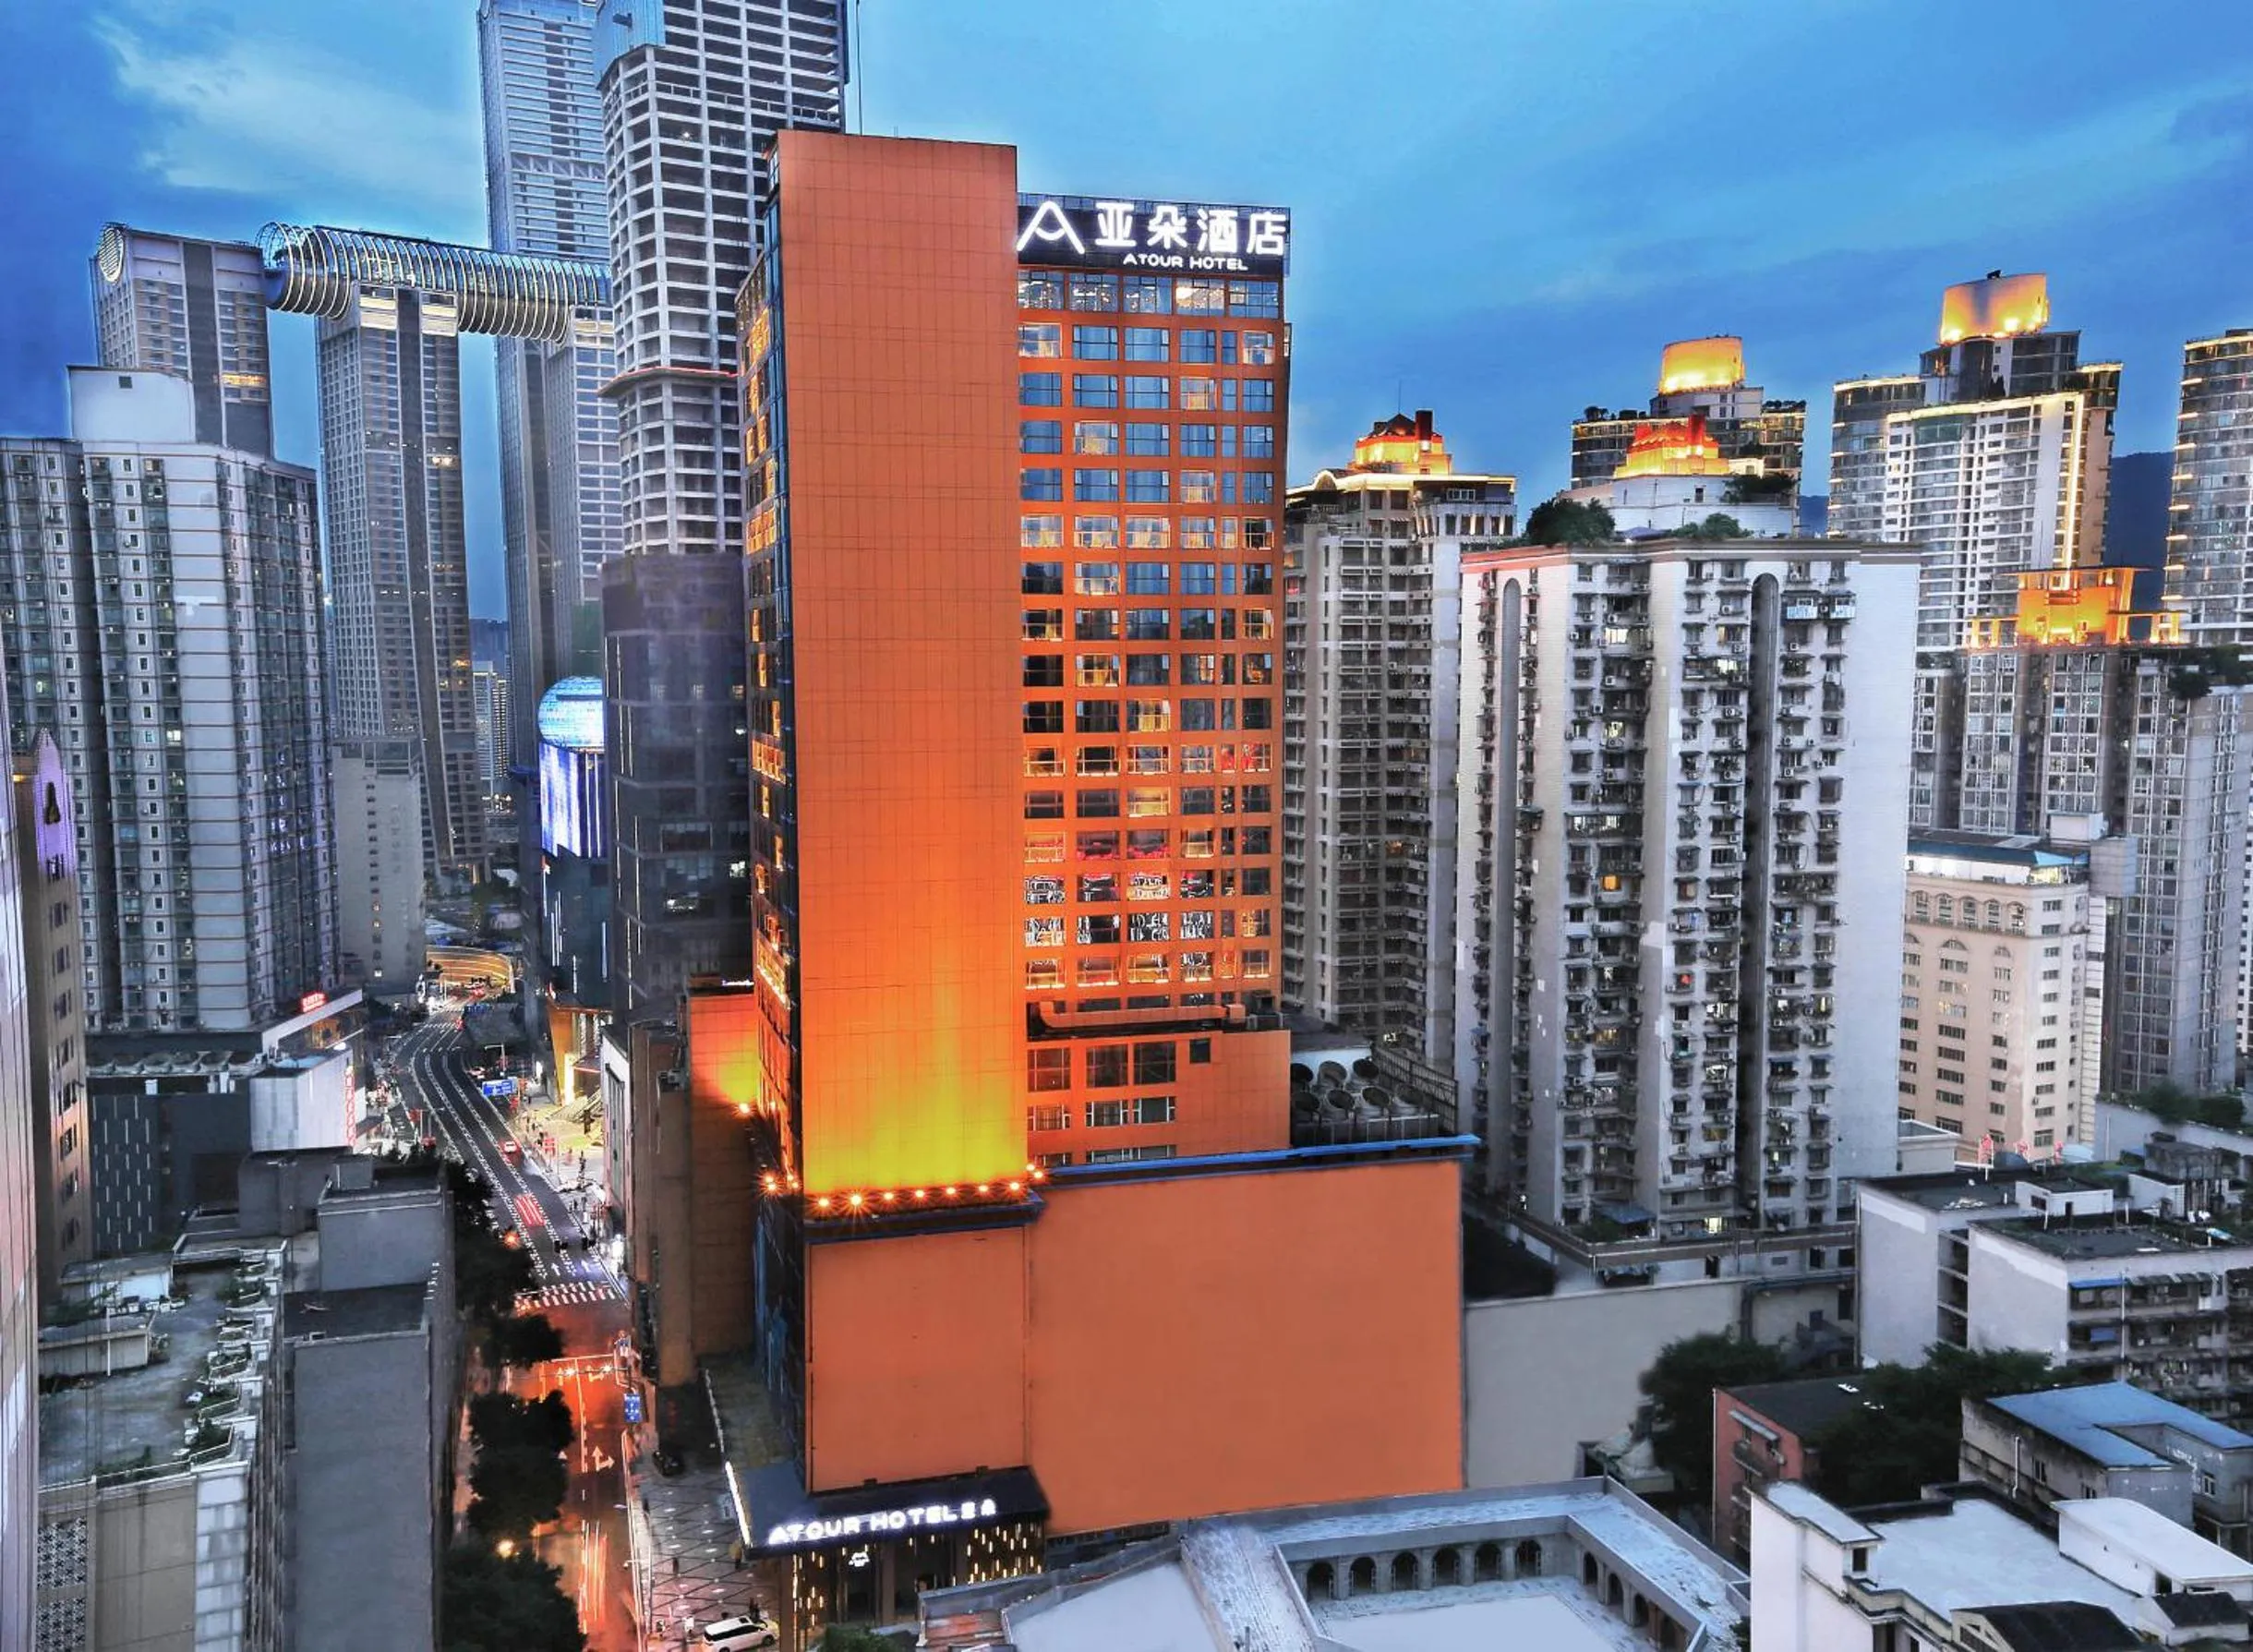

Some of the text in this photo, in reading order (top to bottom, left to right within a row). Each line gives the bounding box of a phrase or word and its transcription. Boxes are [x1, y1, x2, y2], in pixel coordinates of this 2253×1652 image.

[1094, 202, 1286, 257] 亚朵酒店
[1123, 253, 1248, 271] ATOUR HOTEL
[768, 1516, 861, 1545] ATOUR
[870, 1505, 958, 1531] HOTEL
